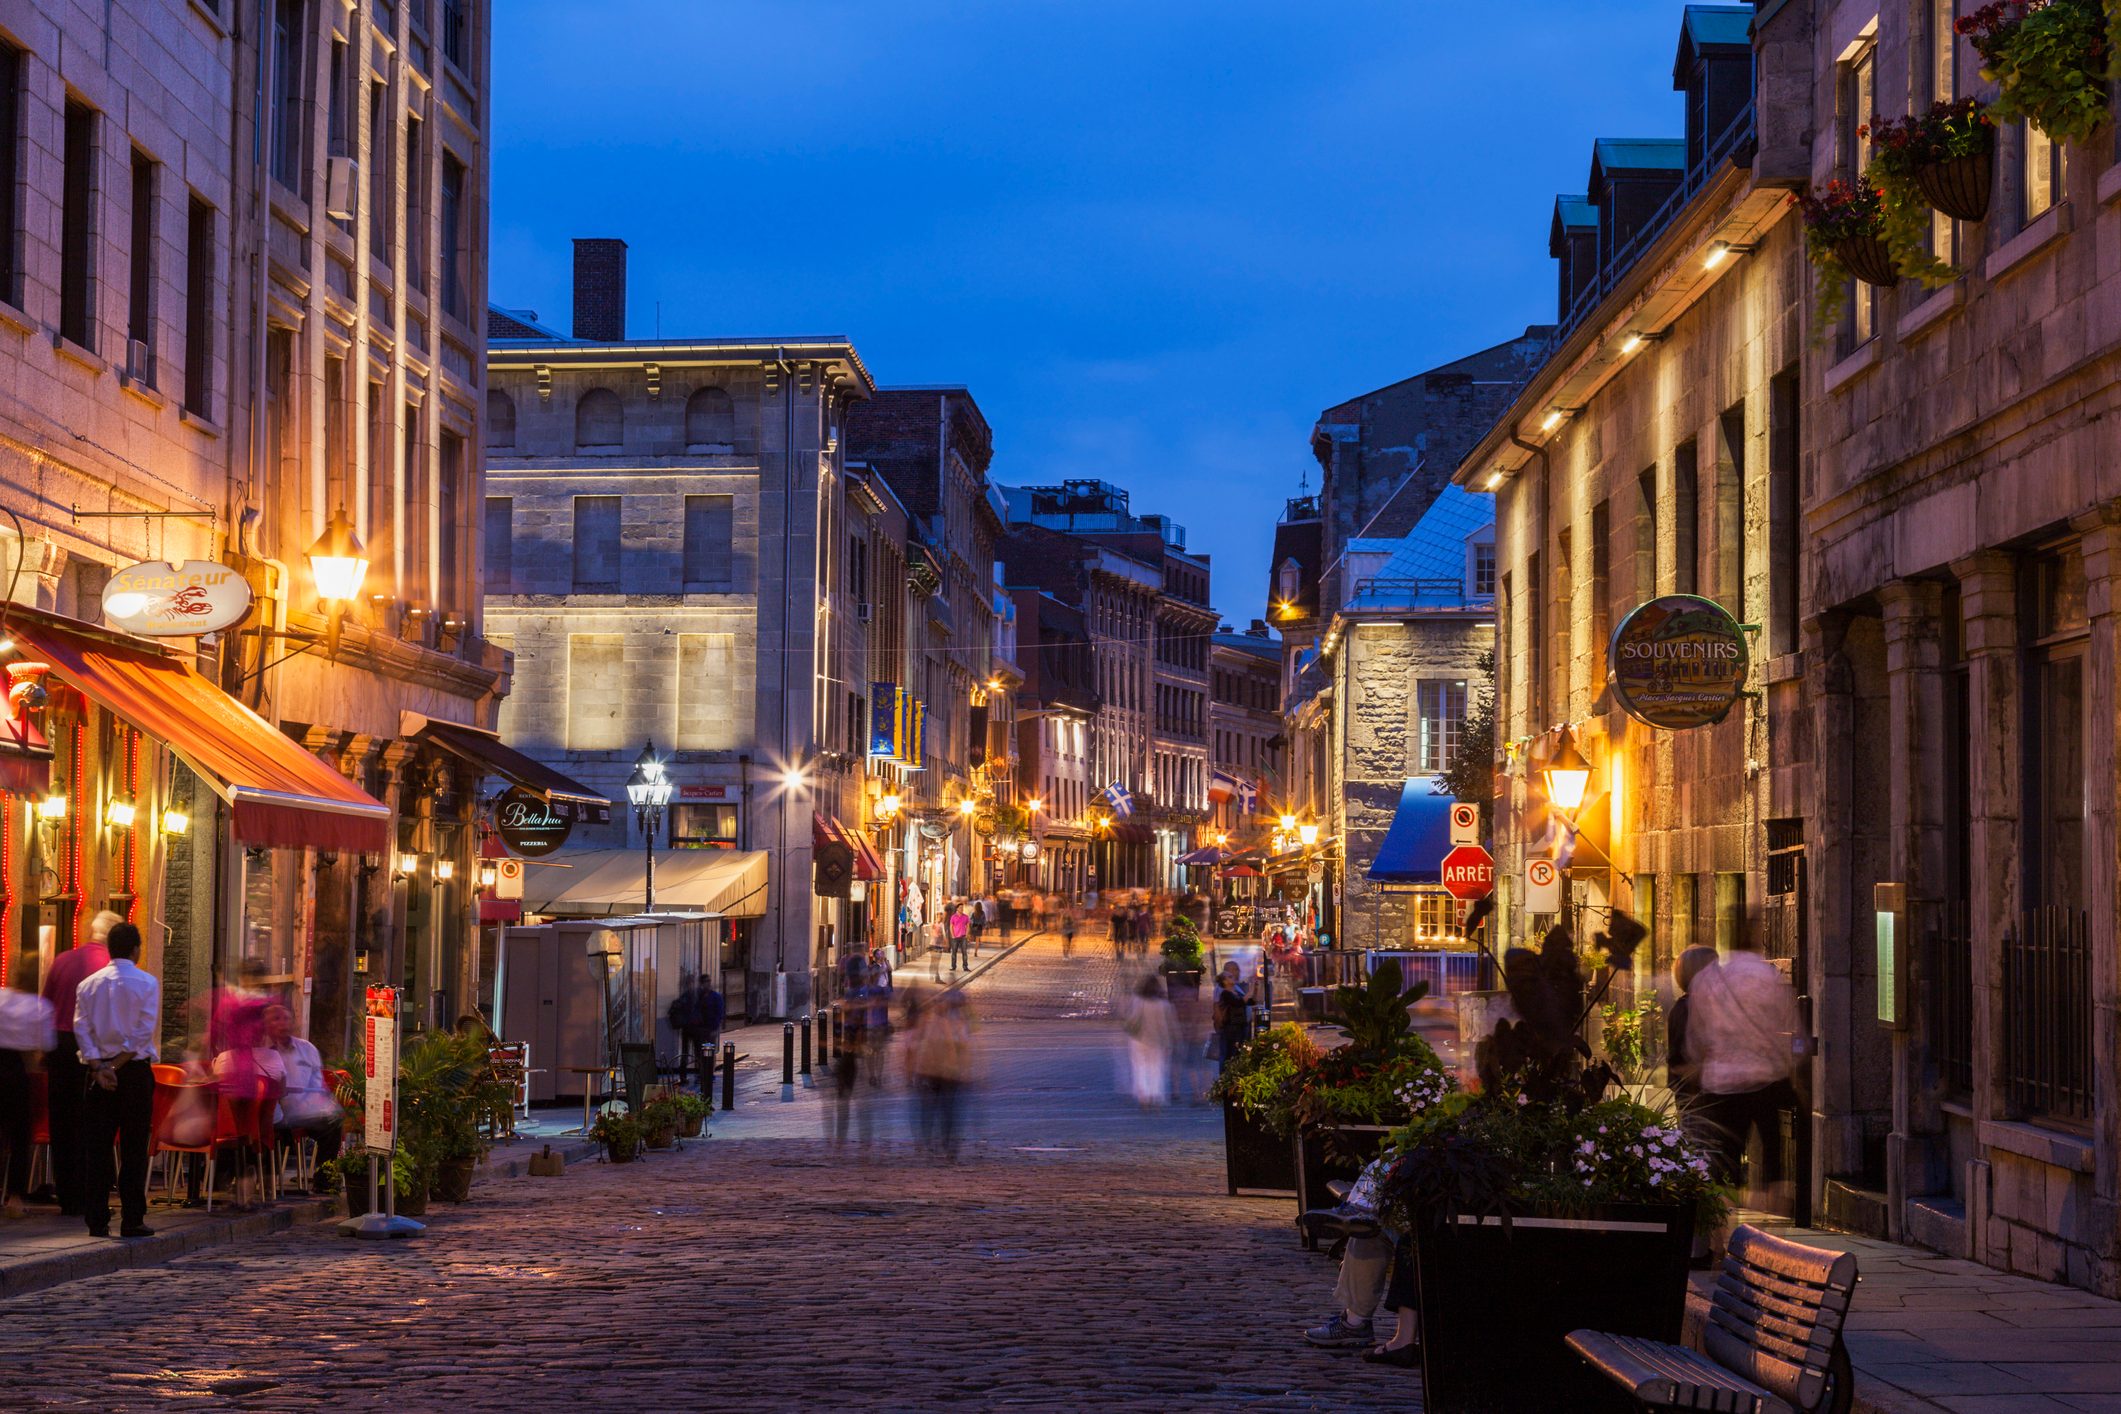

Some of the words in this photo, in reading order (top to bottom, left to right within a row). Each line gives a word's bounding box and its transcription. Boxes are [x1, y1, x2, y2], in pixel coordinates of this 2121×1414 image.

[115, 571, 232, 592] Sénateur
[1624, 642, 1739, 659] SOUVENIRS
[1636, 692, 1661, 702] Place
[1663, 693, 1696, 704] Jacques
[1698, 692, 1726, 702] Cartier
[1445, 863, 1494, 882] ARRÊT
